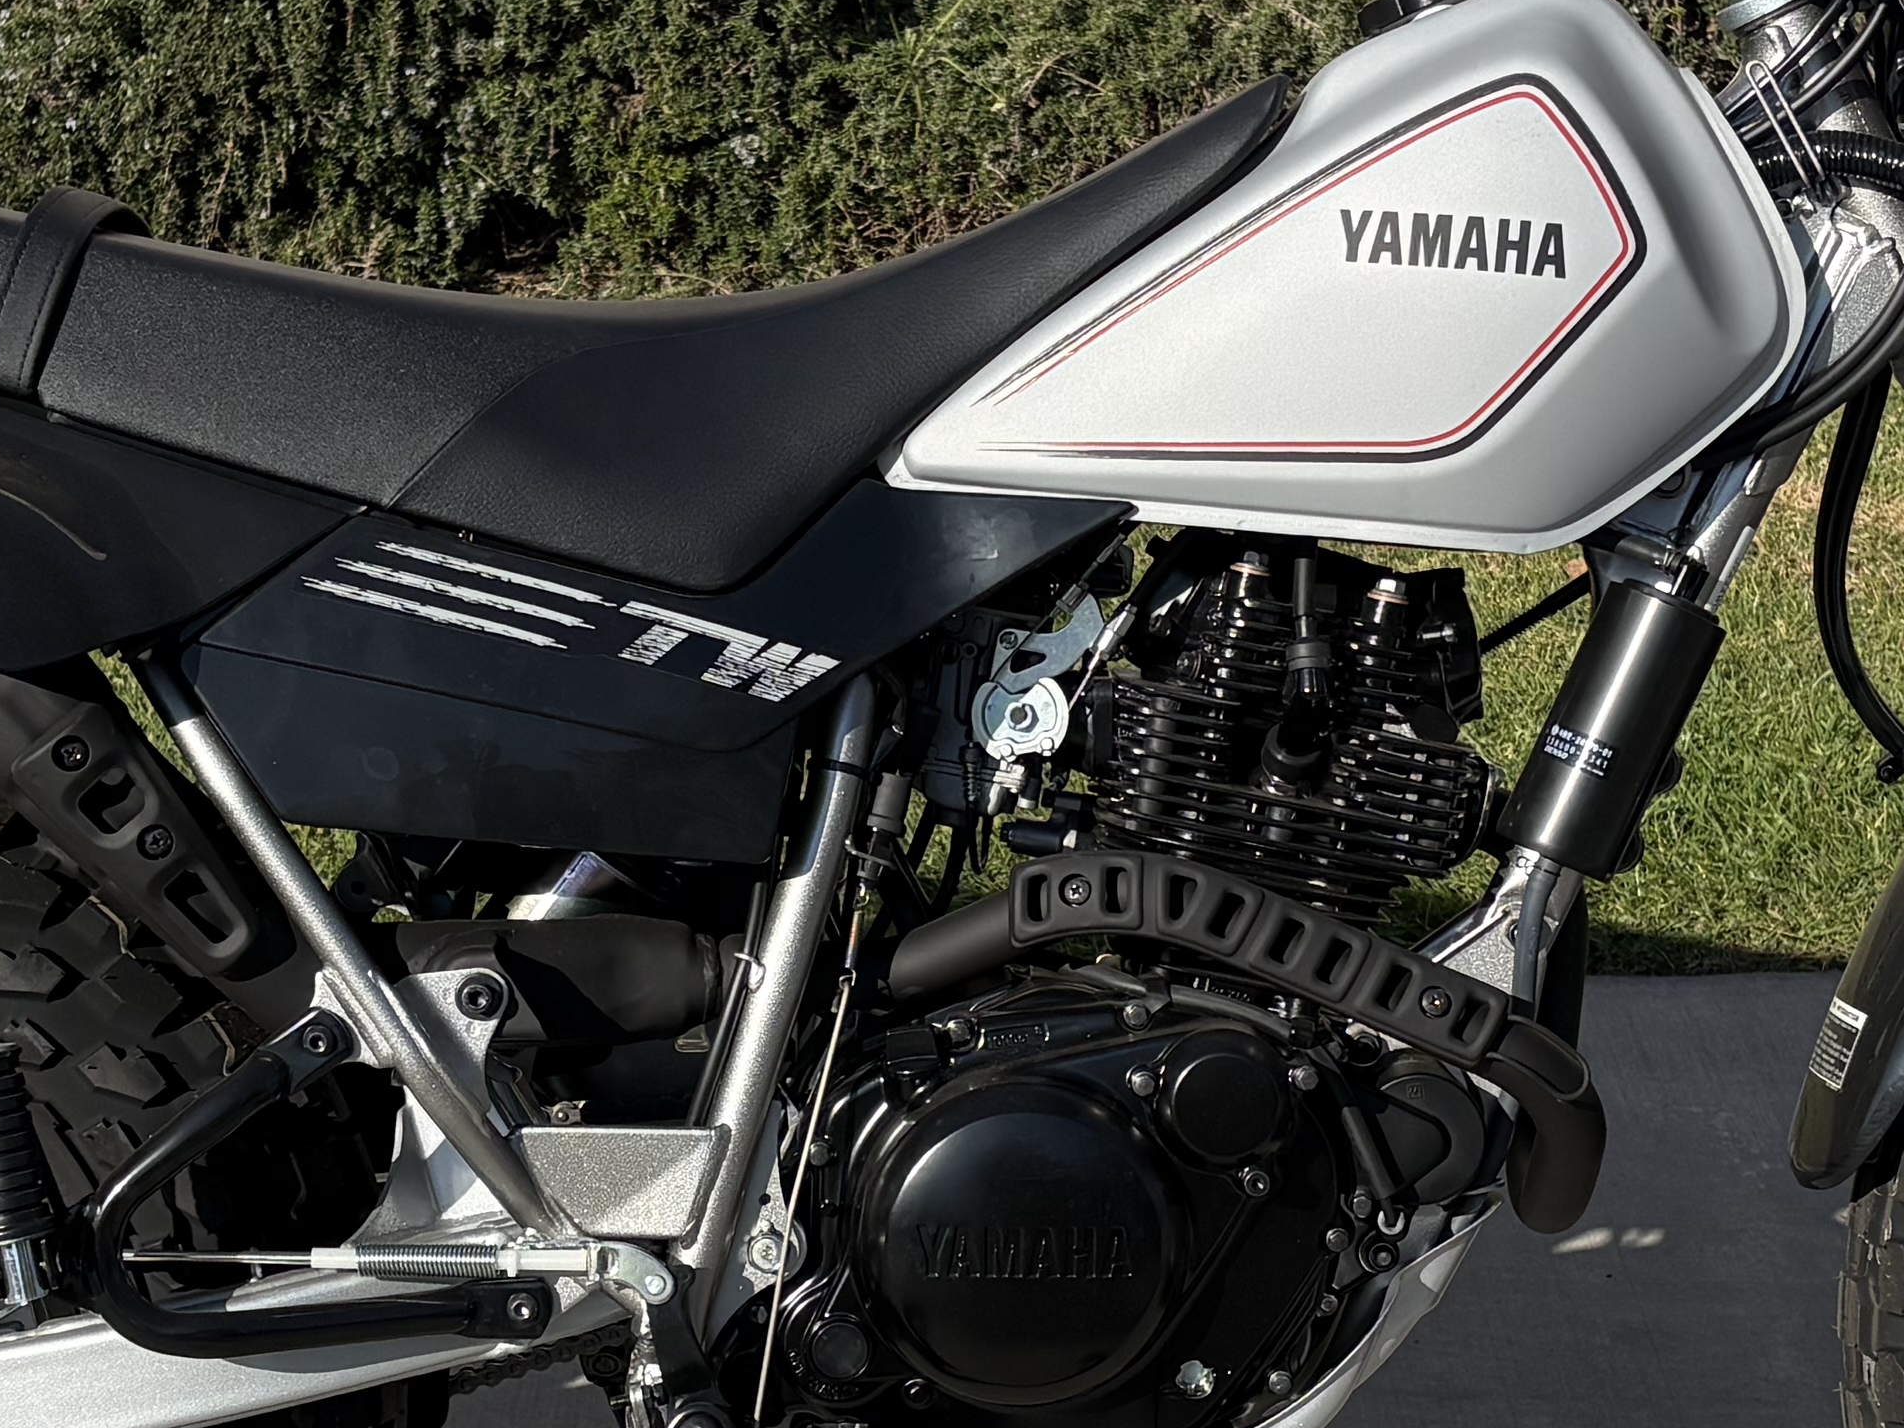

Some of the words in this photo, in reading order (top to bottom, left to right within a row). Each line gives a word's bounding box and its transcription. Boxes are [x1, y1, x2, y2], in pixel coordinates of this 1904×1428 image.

[1340, 209, 1566, 279] YAMAHA
[620, 600, 842, 702] TW
[917, 1221, 1136, 1281] YAMAHA
